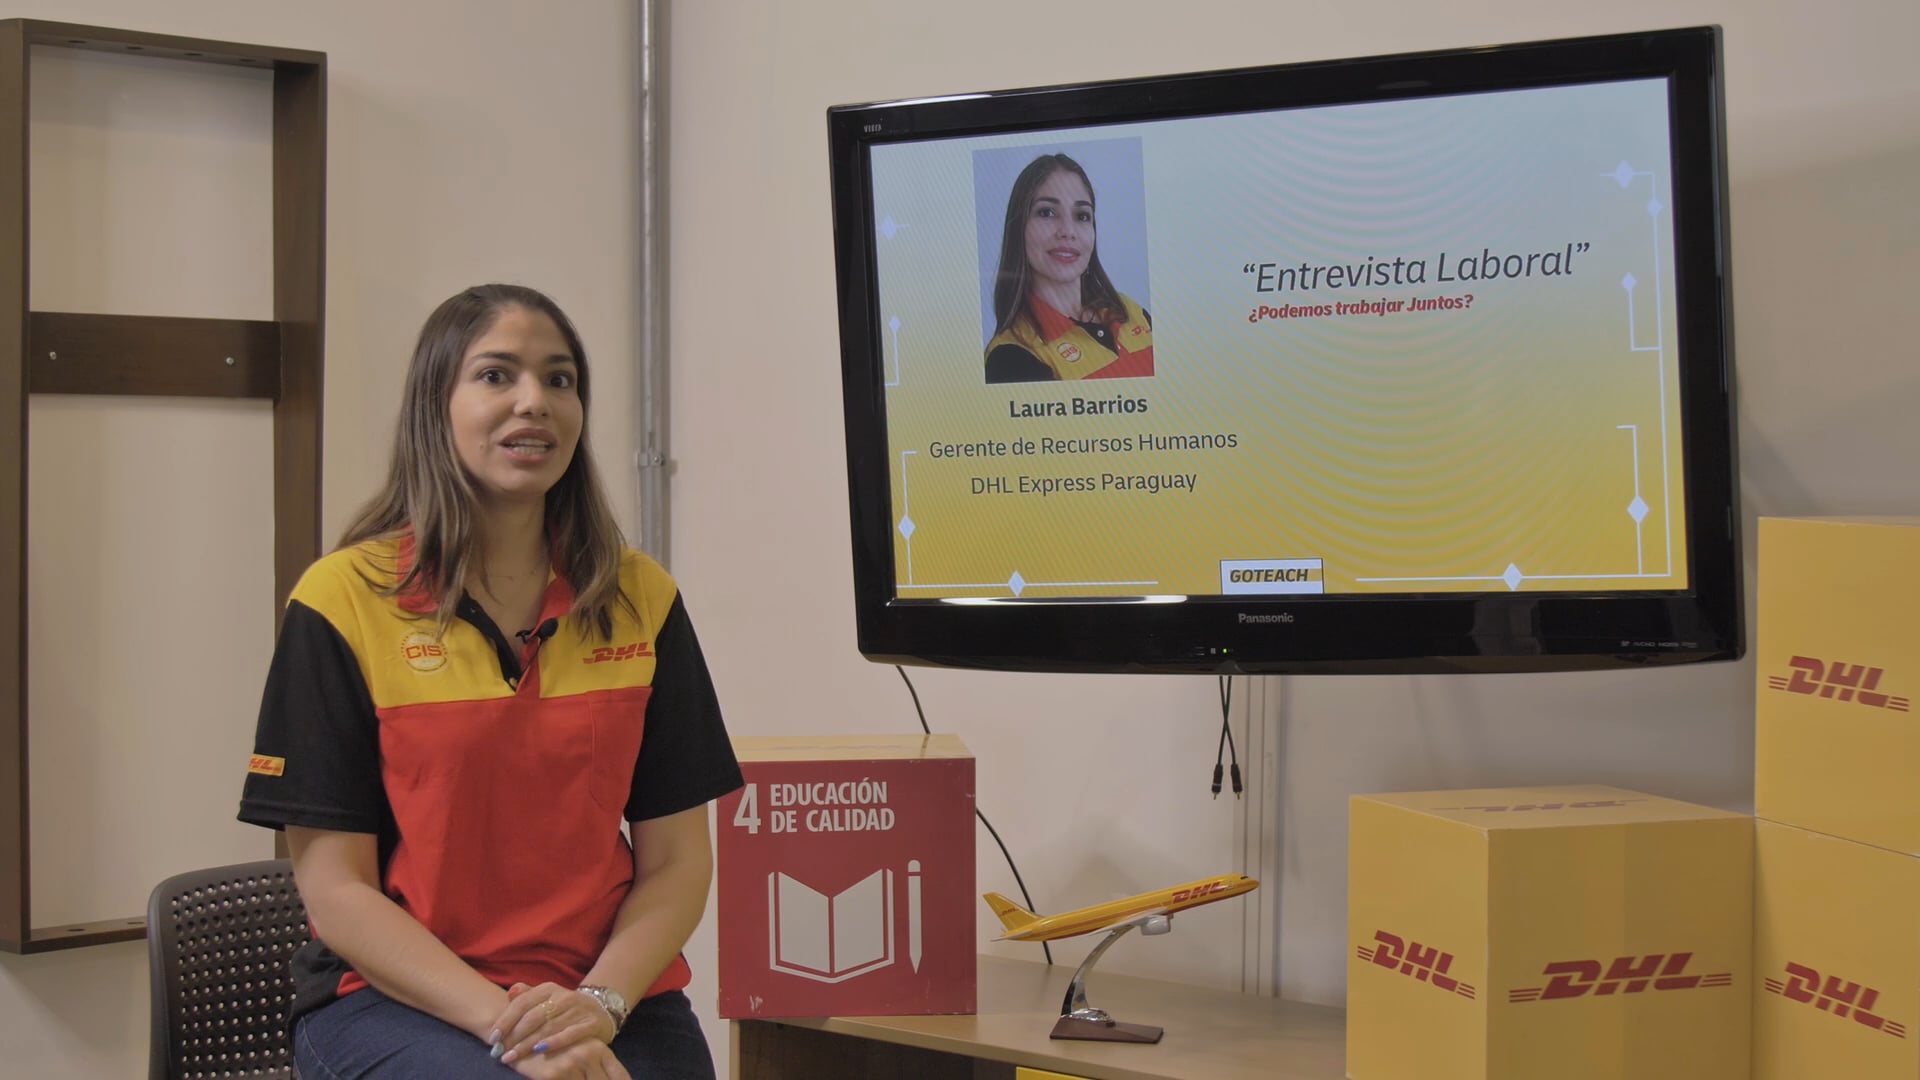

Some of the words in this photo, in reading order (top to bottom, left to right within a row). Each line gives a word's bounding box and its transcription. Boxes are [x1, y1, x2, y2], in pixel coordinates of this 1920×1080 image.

[1243, 256, 1426, 293] “Entrevista
[1437, 242, 1591, 282] Laboral”
[1248, 302, 1332, 323] ¿Podemos
[1335, 298, 1404, 318] trabajar
[1406, 294, 1474, 312] Juntos?
[1009, 399, 1067, 418] Laura
[1071, 394, 1148, 416] Barrios
[929, 438, 1006, 458] Gerente
[1012, 437, 1036, 455] de
[1041, 435, 1133, 455] Recursos
[1138, 431, 1238, 452] Humanos
[971, 476, 1014, 494] DHL
[1019, 474, 1096, 496] Express
[1101, 471, 1197, 494] Paraguay
[1229, 568, 1309, 583] GOTEACH
[1237, 612, 1295, 624] Panasonic
[406, 645, 442, 659] CIS
[591, 641, 655, 664] DHL
[1786, 655, 1890, 708] DHL
[770, 777, 888, 806] EDUCACIÓN
[733, 783, 761, 834] 4
[770, 810, 798, 833] DE
[806, 807, 895, 832] CALIDAD
[1172, 881, 1226, 904] DHL
[1372, 929, 1459, 993] DHL
[1540, 952, 1703, 1000] DHL
[1783, 961, 1886, 1031] DHL
